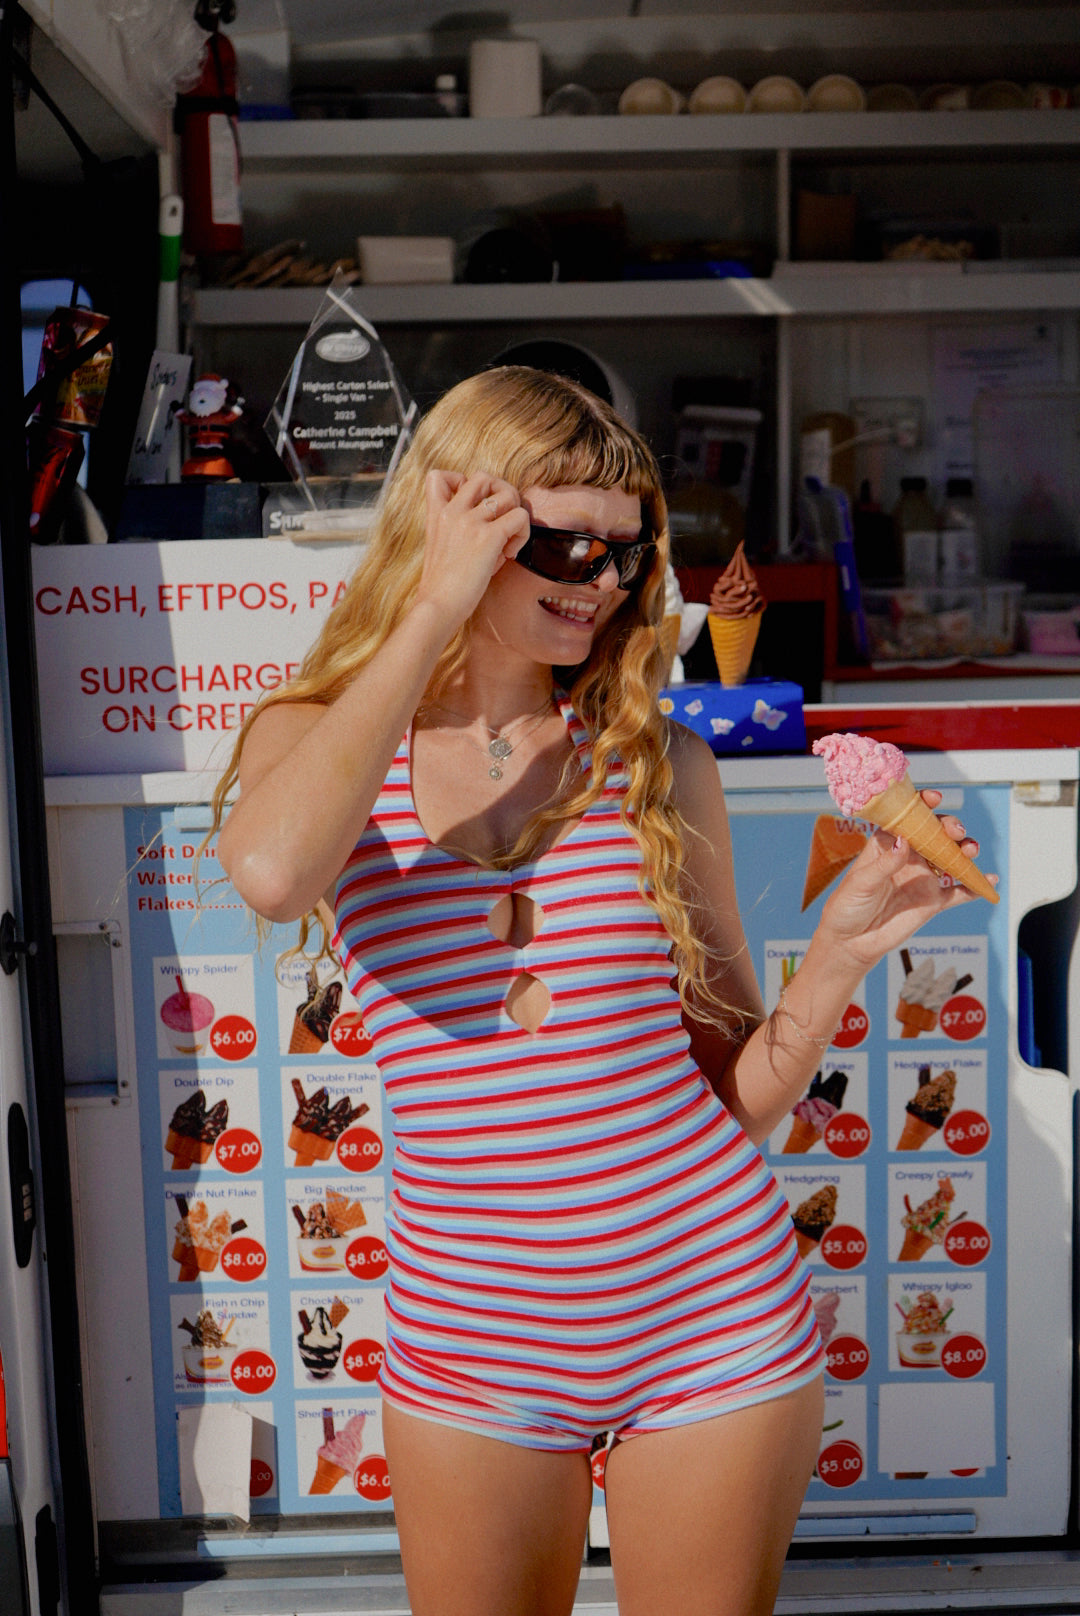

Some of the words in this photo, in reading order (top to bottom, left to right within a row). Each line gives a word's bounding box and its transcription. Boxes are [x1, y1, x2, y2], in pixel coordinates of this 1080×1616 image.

[293, 427, 346, 438] Catherine
[348, 425, 398, 438] Campbell
[36, 586, 147, 617] CASH,
[158, 582, 297, 614] EFTPOS,
[309, 581, 348, 609] PA
[102, 705, 155, 732] ON
[137, 844, 175, 859] Soft
[137, 872, 193, 885] Water
[909, 946, 948, 955] Double
[950, 945, 980, 954] Flake
[160, 965, 199, 977] Whippy
[204, 964, 238, 975] Spider
[942, 1009, 984, 1026] $7.00
[212, 1030, 254, 1046] $6.00
[826, 1062, 855, 1071] Flake
[894, 1060, 949, 1070] Hedgehog
[953, 1059, 982, 1068] Flake
[174, 1078, 212, 1088] Double
[216, 1077, 234, 1088] Dip
[306, 1073, 345, 1082] Double
[348, 1072, 376, 1081] Flake
[323, 1086, 364, 1096] Dipped
[827, 1128, 868, 1144] $6.00
[946, 1122, 987, 1143] $6.00
[218, 1142, 259, 1160] $7.00
[339, 1143, 380, 1157] $8.00
[784, 1174, 840, 1185] Hedgehog
[895, 1171, 934, 1181] Creepy
[165, 1190, 202, 1199] Double
[206, 1189, 225, 1198] Nut
[228, 1188, 257, 1197] Flake
[304, 1184, 323, 1195] Big
[325, 1184, 366, 1193] Sundae
[823, 1240, 865, 1256] $5.00
[946, 1236, 989, 1252] $5.00
[223, 1252, 264, 1267] $8.00
[347, 1249, 387, 1268] $8.00
[810, 1285, 858, 1294] Sherbert
[902, 1282, 942, 1292] Whippy
[946, 1282, 972, 1291] Igloo
[205, 1299, 229, 1307] Fish
[240, 1298, 265, 1308] Chip
[343, 1295, 363, 1305] Cup
[217, 1310, 257, 1320] Sundae
[346, 1351, 385, 1370] $8.00
[827, 1350, 867, 1367] $5.00
[943, 1350, 984, 1366] $8.00
[233, 1365, 274, 1380] $8.00
[348, 1407, 376, 1417] Flake
[821, 1457, 861, 1474] $5.00
[359, 1470, 391, 1487] $6.0
